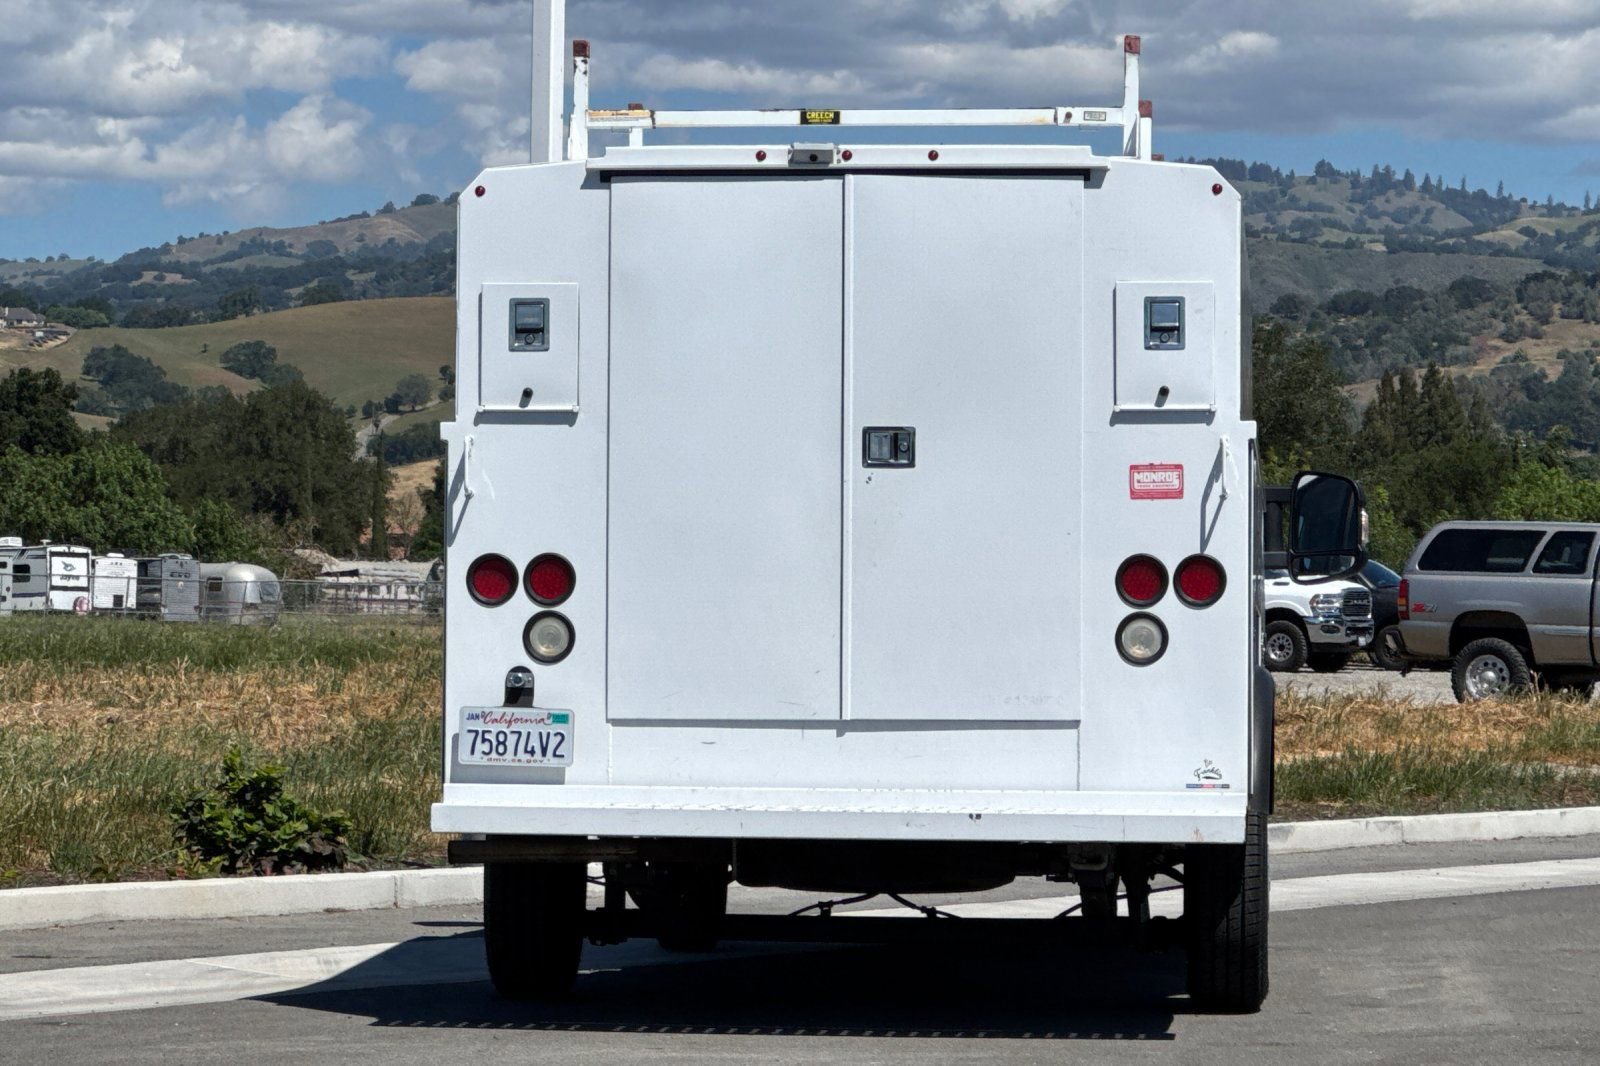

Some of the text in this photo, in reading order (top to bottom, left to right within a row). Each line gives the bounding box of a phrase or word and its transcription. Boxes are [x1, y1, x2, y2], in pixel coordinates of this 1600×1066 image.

[1134, 471, 1180, 483] MONROE
[466, 712, 480, 721] JAN
[482, 711, 551, 728] California
[466, 729, 566, 758] 75874V2
